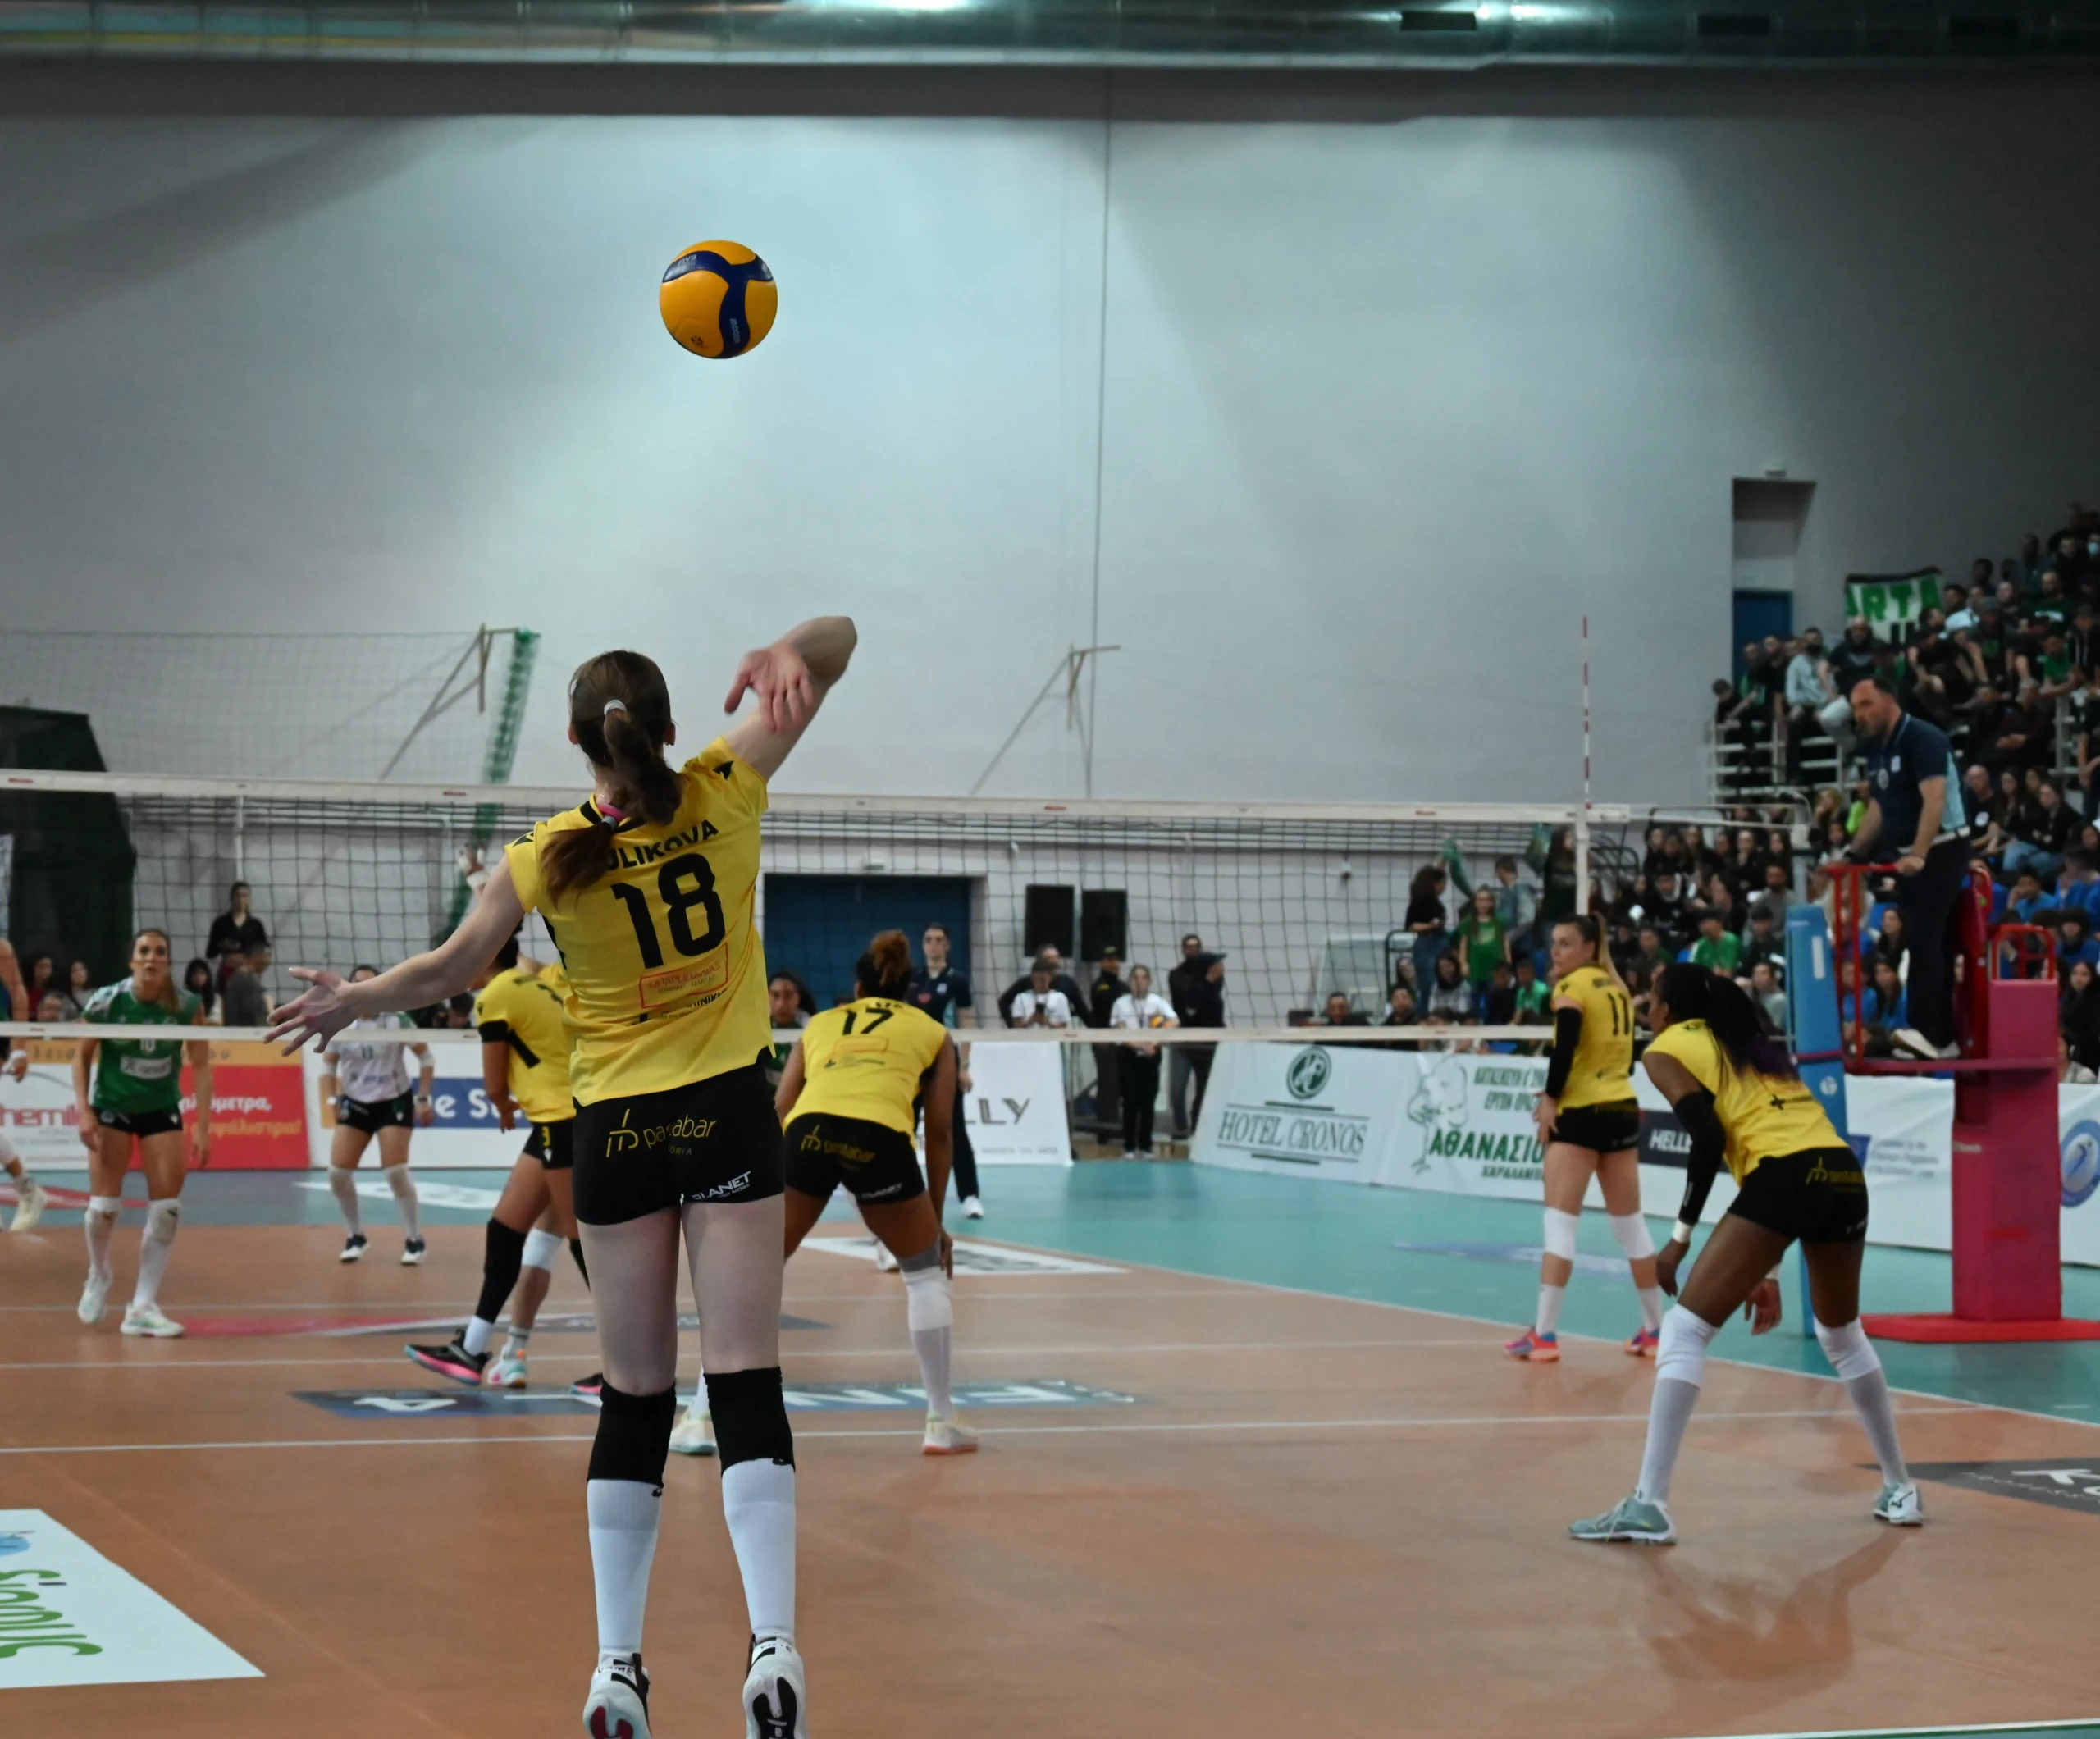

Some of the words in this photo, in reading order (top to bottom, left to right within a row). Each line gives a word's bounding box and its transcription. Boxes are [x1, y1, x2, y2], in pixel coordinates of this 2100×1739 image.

[610, 853, 726, 969] 18
[842, 1007, 894, 1036] 17
[1607, 992, 1630, 1036] 11
[1217, 1111, 1283, 1146] HOTEL
[1288, 1118, 1368, 1156] CRONOS
[504, 1385, 1077, 1409] FINL
